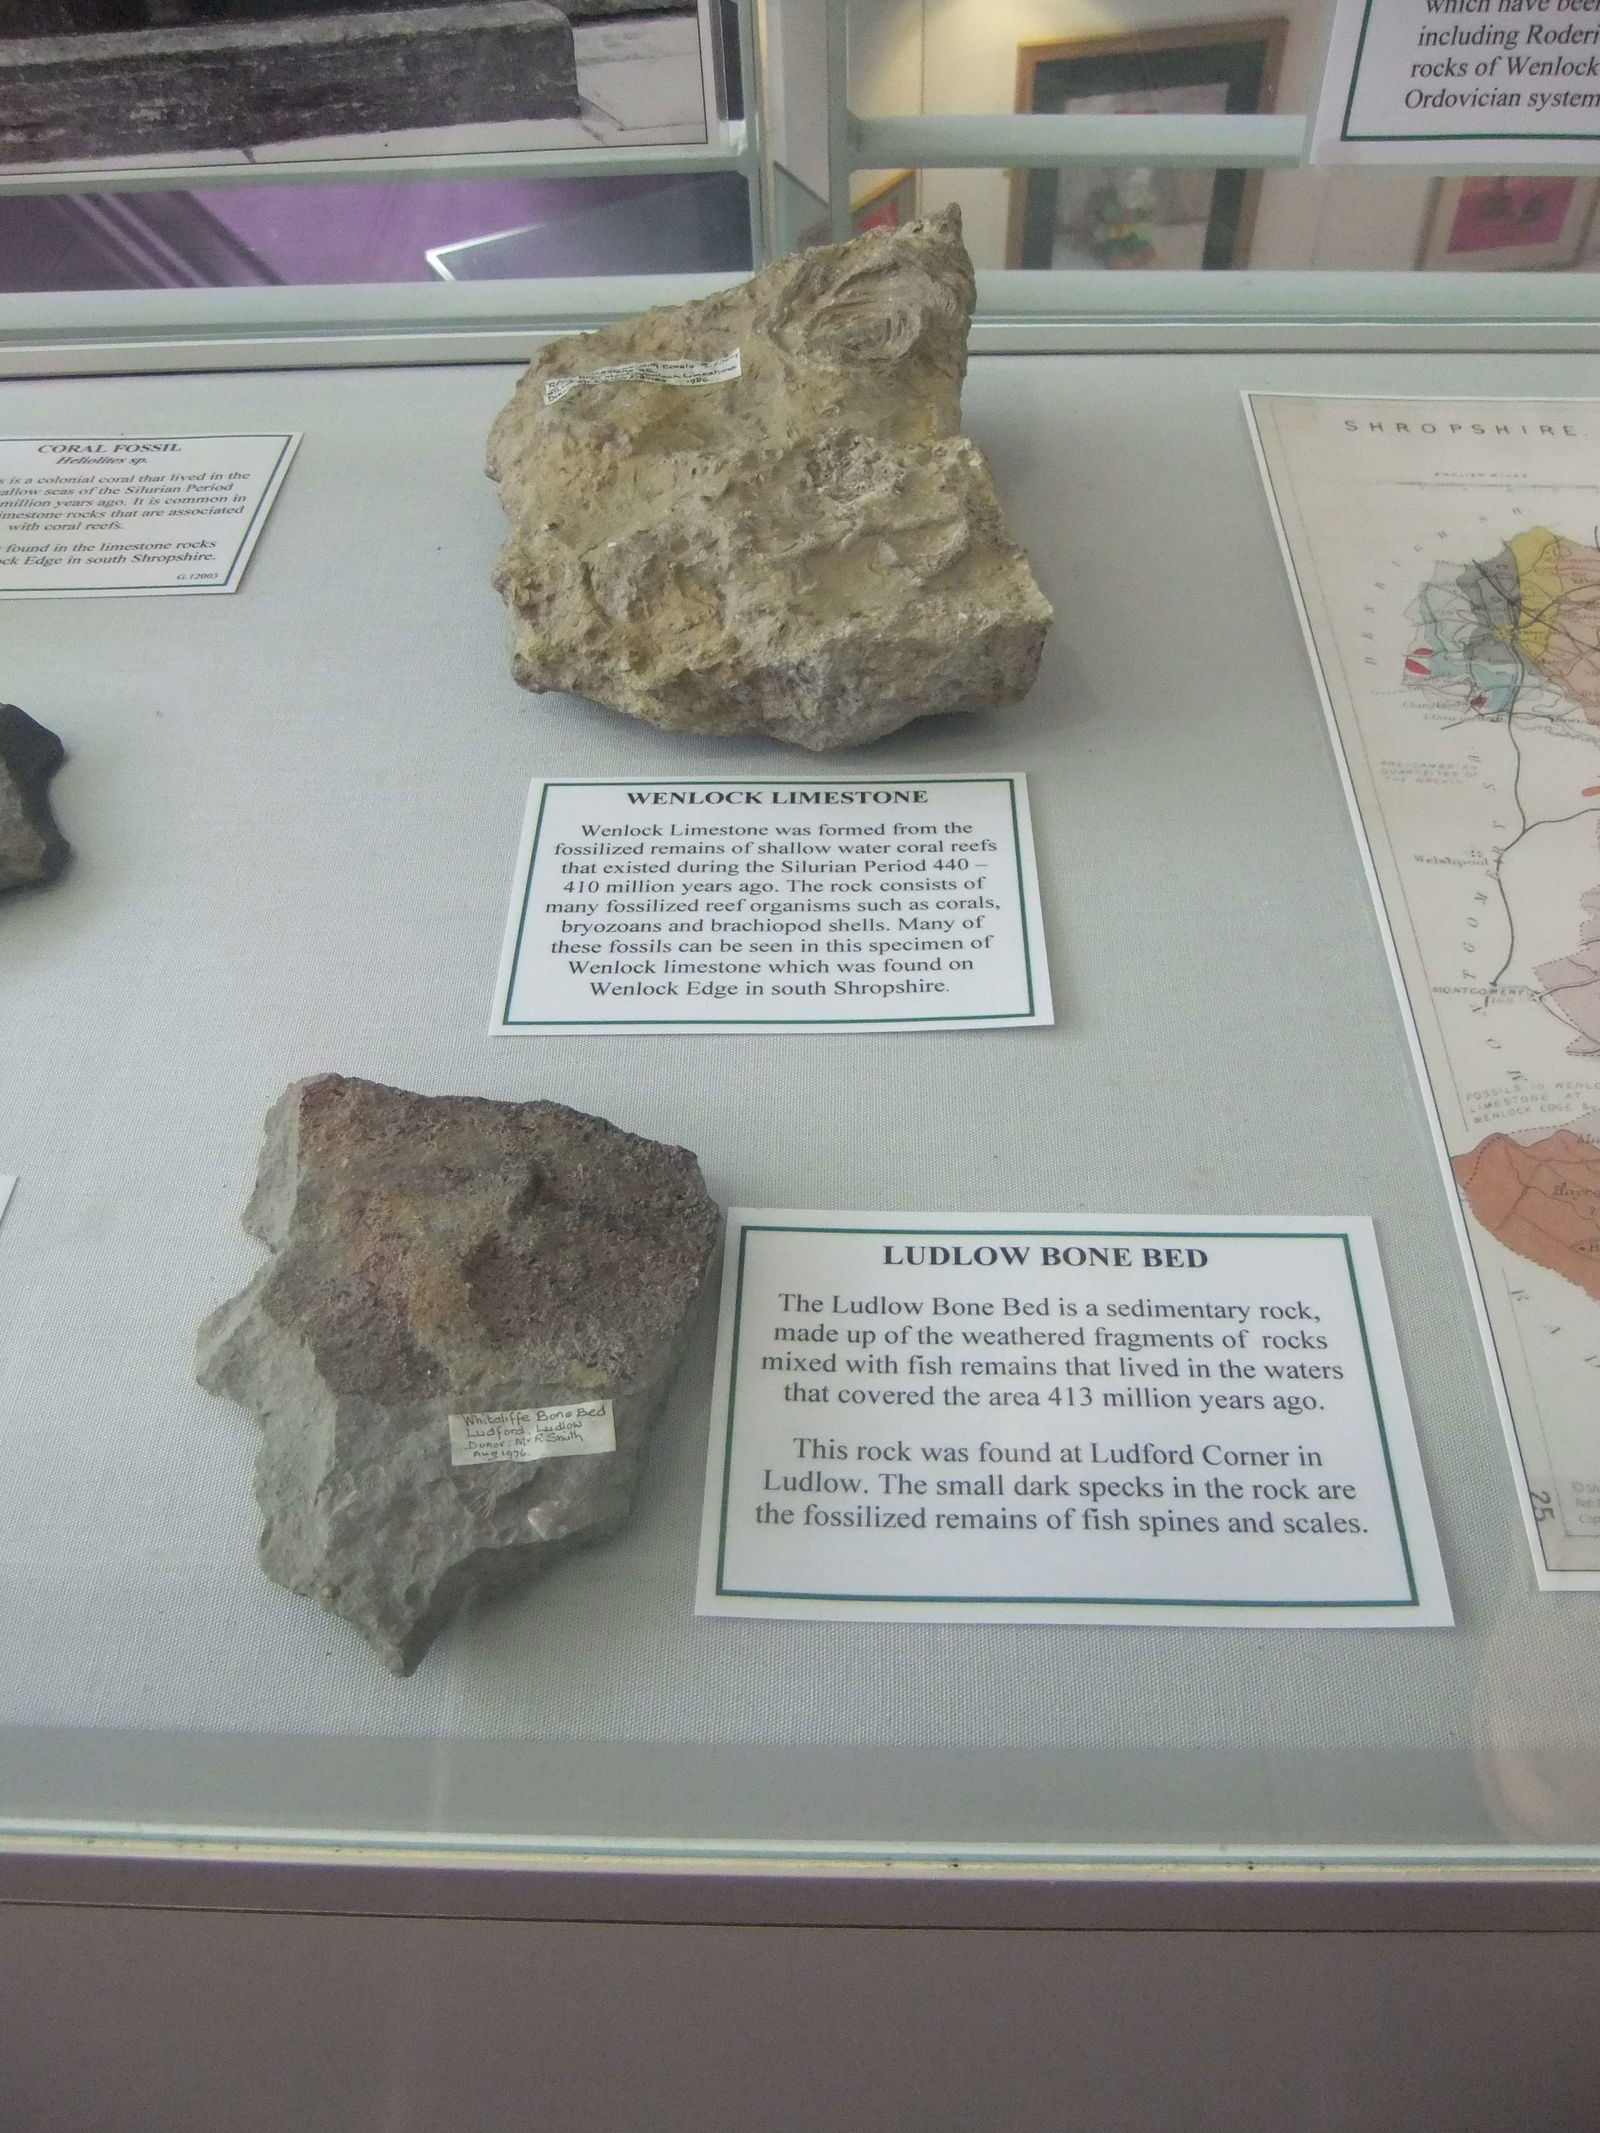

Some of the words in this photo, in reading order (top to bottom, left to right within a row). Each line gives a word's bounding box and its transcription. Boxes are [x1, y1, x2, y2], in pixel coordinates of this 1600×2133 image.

[1425, 0, 1491, 14] which
[1497, 0, 1551, 13] have
[1417, 23, 1521, 51] including
[1410, 56, 1469, 78] rocks
[1474, 55, 1503, 77] of
[1506, 55, 1600, 77] Wenlock
[1404, 87, 1522, 109] Ordovician
[37, 444, 108, 454] CORAL
[112, 443, 182, 454] FOSSIL
[55, 455, 128, 465] Heliolites
[9, 476, 22, 485] is
[24, 477, 34, 485] a
[36, 475, 96, 485] colonial
[98, 474, 136, 484] coral
[138, 473, 166, 483] that
[169, 472, 208, 482] lived
[209, 471, 224, 481] in
[227, 471, 251, 480] the
[44, 488, 75, 497] seas
[79, 486, 97, 496] of
[99, 485, 121, 496] the
[125, 484, 182, 495] Silurian
[185, 483, 235, 493] Period
[0, 498, 52, 508] million
[52, 499, 95, 509] years
[96, 499, 127, 509] ago.
[132, 496, 145, 506] It
[147, 496, 161, 506] is
[164, 496, 229, 505] common
[232, 493, 247, 503] in
[65, 509, 107, 519] rocks
[109, 509, 139, 518] that
[140, 510, 166, 518] are
[167, 504, 247, 516] associated
[8, 521, 41, 532] with
[43, 521, 83, 531] coral
[84, 520, 124, 531] reefs.
[5, 543, 51, 553] found
[52, 543, 69, 553] in
[71, 542, 96, 553] the
[99, 542, 173, 552] limestone
[175, 539, 217, 550] rocks
[23, 555, 64, 568] Edge
[66, 555, 82, 565] in
[85, 553, 127, 565] south
[130, 551, 216, 565] Shropshire.
[626, 791, 763, 806] WENLOCK
[771, 789, 929, 805] LIMESTONE
[581, 823, 664, 837] Wenlock
[670, 823, 769, 837] Limestone
[775, 826, 812, 837] was
[818, 823, 886, 837] formed
[892, 822, 938, 836] from
[943, 821, 973, 835] the
[554, 841, 645, 856] fossilized
[650, 841, 726, 855] remains
[731, 840, 755, 855] of
[757, 841, 832, 855] shallow
[837, 842, 892, 855] water
[896, 839, 944, 854] coral
[950, 838, 998, 853] reefs
[562, 880, 600, 894] 410
[605, 879, 675, 894] million
[680, 882, 733, 896] years
[738, 882, 780, 896] ago.
[786, 879, 825, 893] The
[830, 878, 873, 893] rock
[879, 877, 958, 893] consists
[963, 876, 987, 890] of
[561, 919, 662, 937] bryozoans
[667, 918, 704, 933] and
[710, 918, 822, 936] brachiopod
[828, 917, 891, 933] shells.
[898, 916, 956, 934] Many
[961, 915, 986, 930] of
[567, 959, 657, 975] Wenlock
[663, 959, 762, 974] limestone
[768, 959, 830, 974] which
[836, 962, 877, 974] was
[882, 956, 943, 973] found
[948, 959, 974, 971] on
[589, 980, 680, 997] Wenlock
[685, 980, 739, 1000] Edge
[745, 980, 765, 996] in
[770, 980, 827, 996] south
[833, 978, 950, 999] Shropshire.
[882, 1245, 1031, 1267] LUDLOW
[1039, 1246, 1133, 1268] BONE
[1140, 1247, 1209, 1269] BED
[777, 1292, 824, 1314] The
[832, 1294, 925, 1316] Ludlow
[932, 1296, 995, 1317] Bone
[1001, 1297, 1051, 1317] Bed
[1058, 1296, 1079, 1317] is
[1085, 1303, 1100, 1317] a
[1106, 1298, 1251, 1325] sedimentary
[1259, 1300, 1321, 1324] rock,
[774, 1322, 839, 1344] made
[846, 1329, 877, 1350] up
[884, 1324, 914, 1345] of
[916, 1325, 954, 1346] the
[961, 1325, 1086, 1347] weathered
[1093, 1326, 1215, 1353] fragments
[1221, 1328, 1250, 1349] of
[1261, 1329, 1329, 1350] rocks
[783, 1382, 830, 1404] that
[837, 1385, 935, 1406] covered
[942, 1385, 981, 1407] the
[988, 1391, 1041, 1407] area
[1047, 1386, 1093, 1407] 413
[1102, 1386, 1192, 1409] million
[1198, 1394, 1266, 1415] years
[1272, 1395, 1325, 1416] ago.
[537, 1410, 574, 1422] Bone
[576, 1405, 606, 1418] Bed
[536, 1420, 583, 1433] Ludlow
[515, 1437, 531, 1447] Mr
[534, 1433, 544, 1443] R
[545, 1430, 584, 1443] Smith
[473, 1450, 498, 1461] Aug
[754, 1501, 795, 1525] the
[803, 1503, 928, 1529] fossilized
[935, 1506, 1038, 1530] remains
[1046, 1507, 1077, 1530] of
[1081, 1507, 1131, 1531] fish
[1138, 1508, 1220, 1538] spines
[1227, 1510, 1276, 1534] and
[1282, 1511, 1369, 1535] scales.
